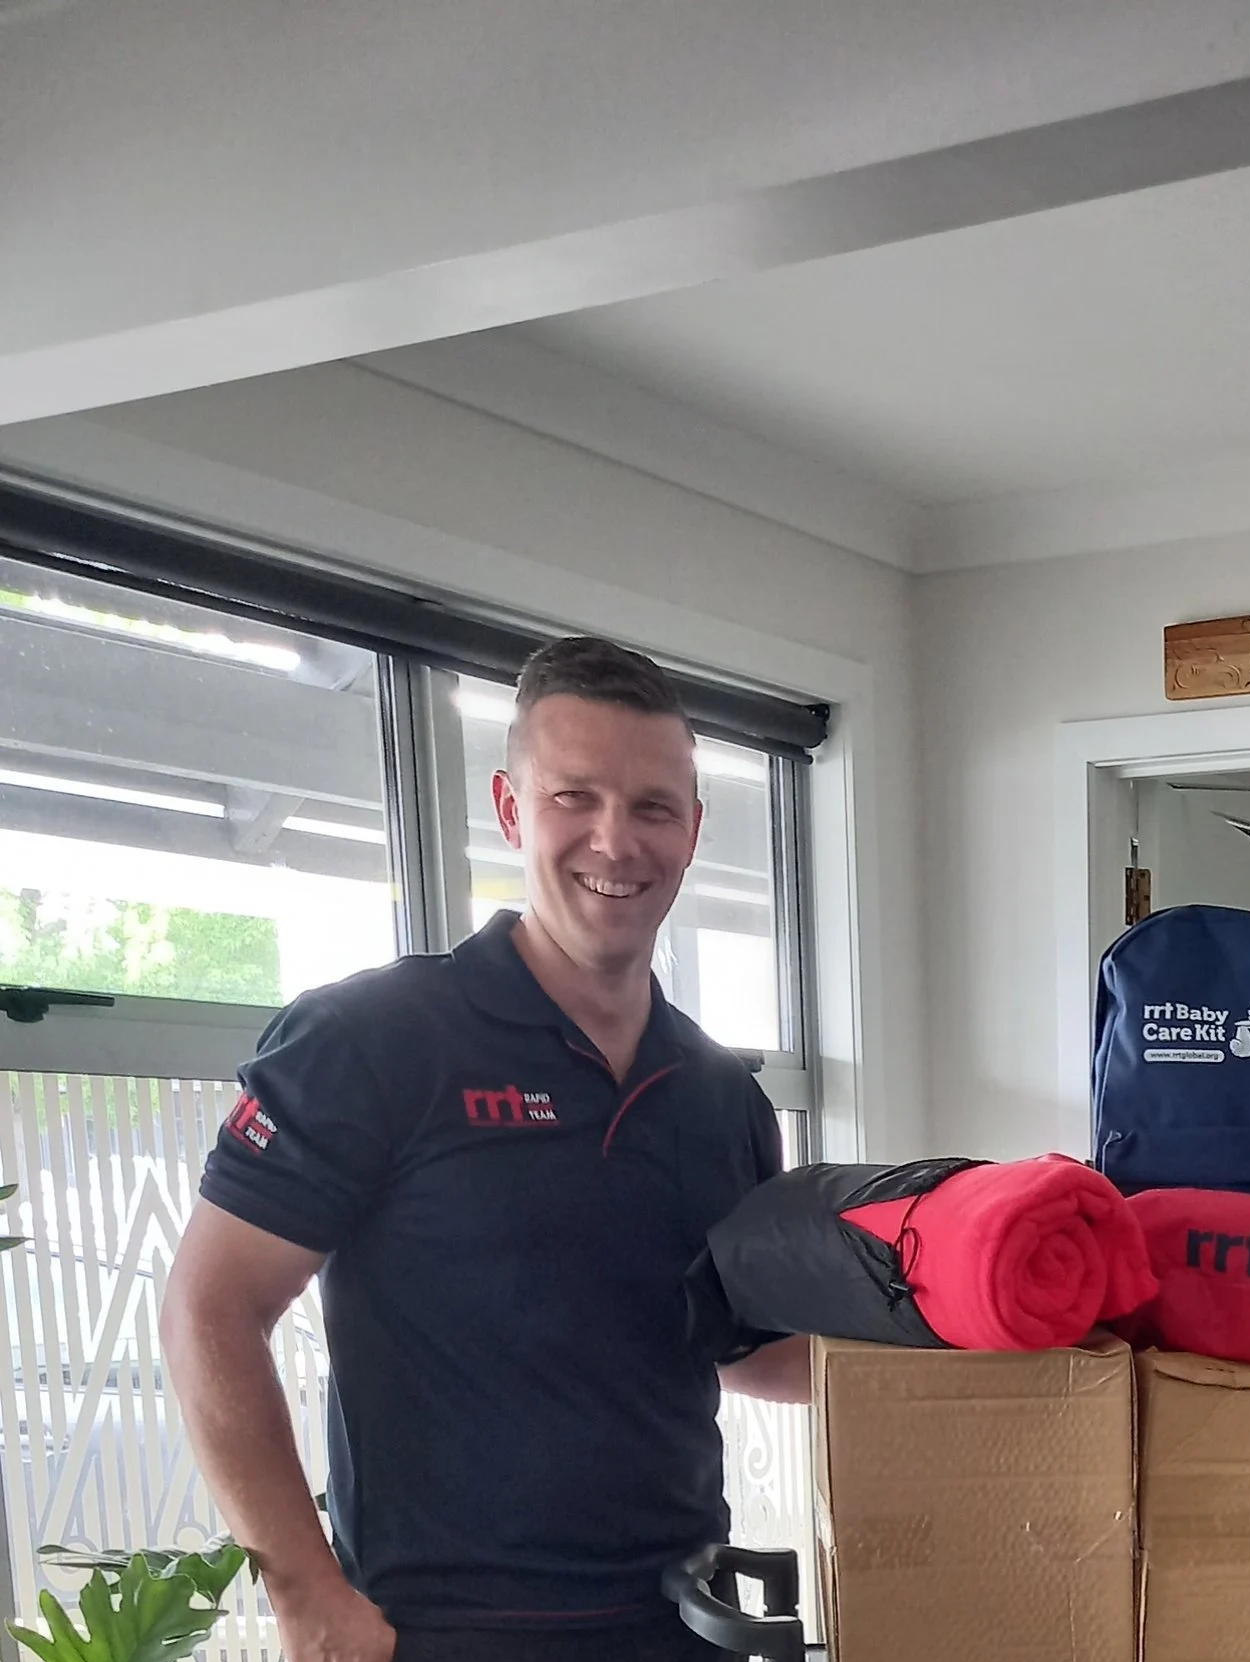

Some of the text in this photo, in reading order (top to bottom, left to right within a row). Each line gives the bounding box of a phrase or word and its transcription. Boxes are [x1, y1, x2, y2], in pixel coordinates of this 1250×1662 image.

[1143, 1002, 1229, 1026] rrt Baby
[1142, 1022, 1226, 1042] Care Kit
[463, 1084, 523, 1120] rrt
[528, 1109, 557, 1121] TEAM
